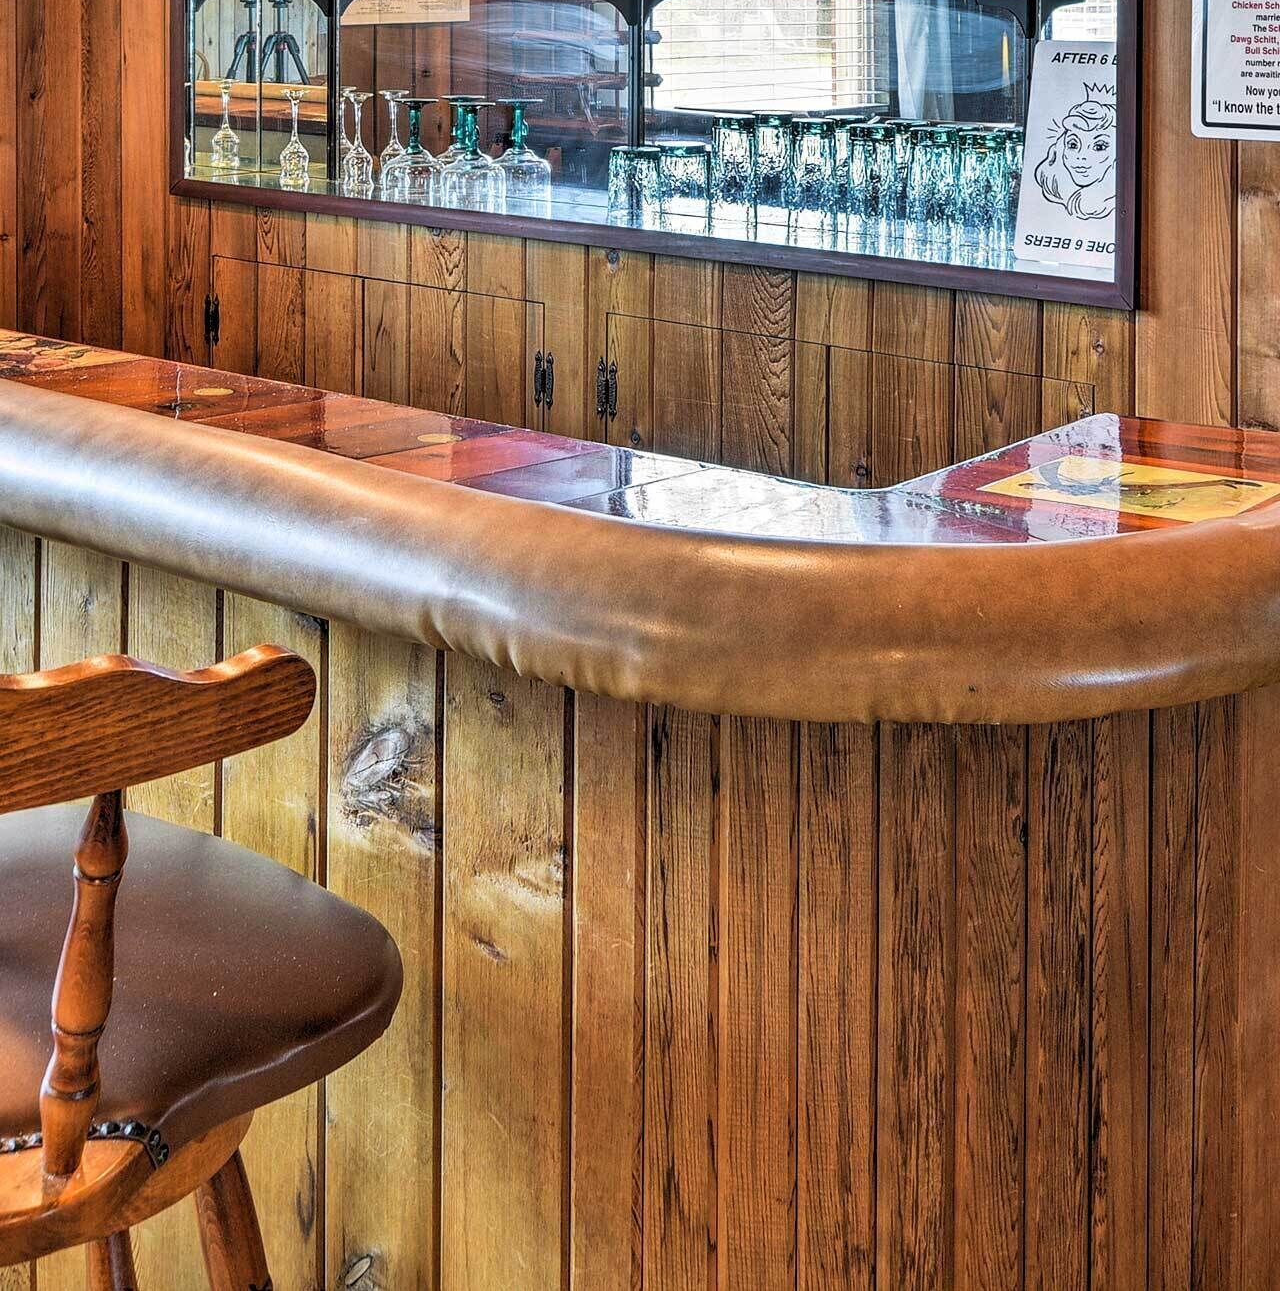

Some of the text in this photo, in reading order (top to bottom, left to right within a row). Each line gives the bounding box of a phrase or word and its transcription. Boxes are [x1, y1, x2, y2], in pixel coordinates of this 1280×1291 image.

[1251, 24, 1267, 32] The
[1244, 46, 1260, 54] Bull
[1051, 53, 1097, 65] AFTER
[1100, 54, 1109, 65] 6
[1245, 85, 1265, 96] Now
[1224, 100, 1255, 113] know
[1255, 101, 1275, 114] the
[1024, 234, 1072, 249] BEERS
[1074, 239, 1083, 250] 6
